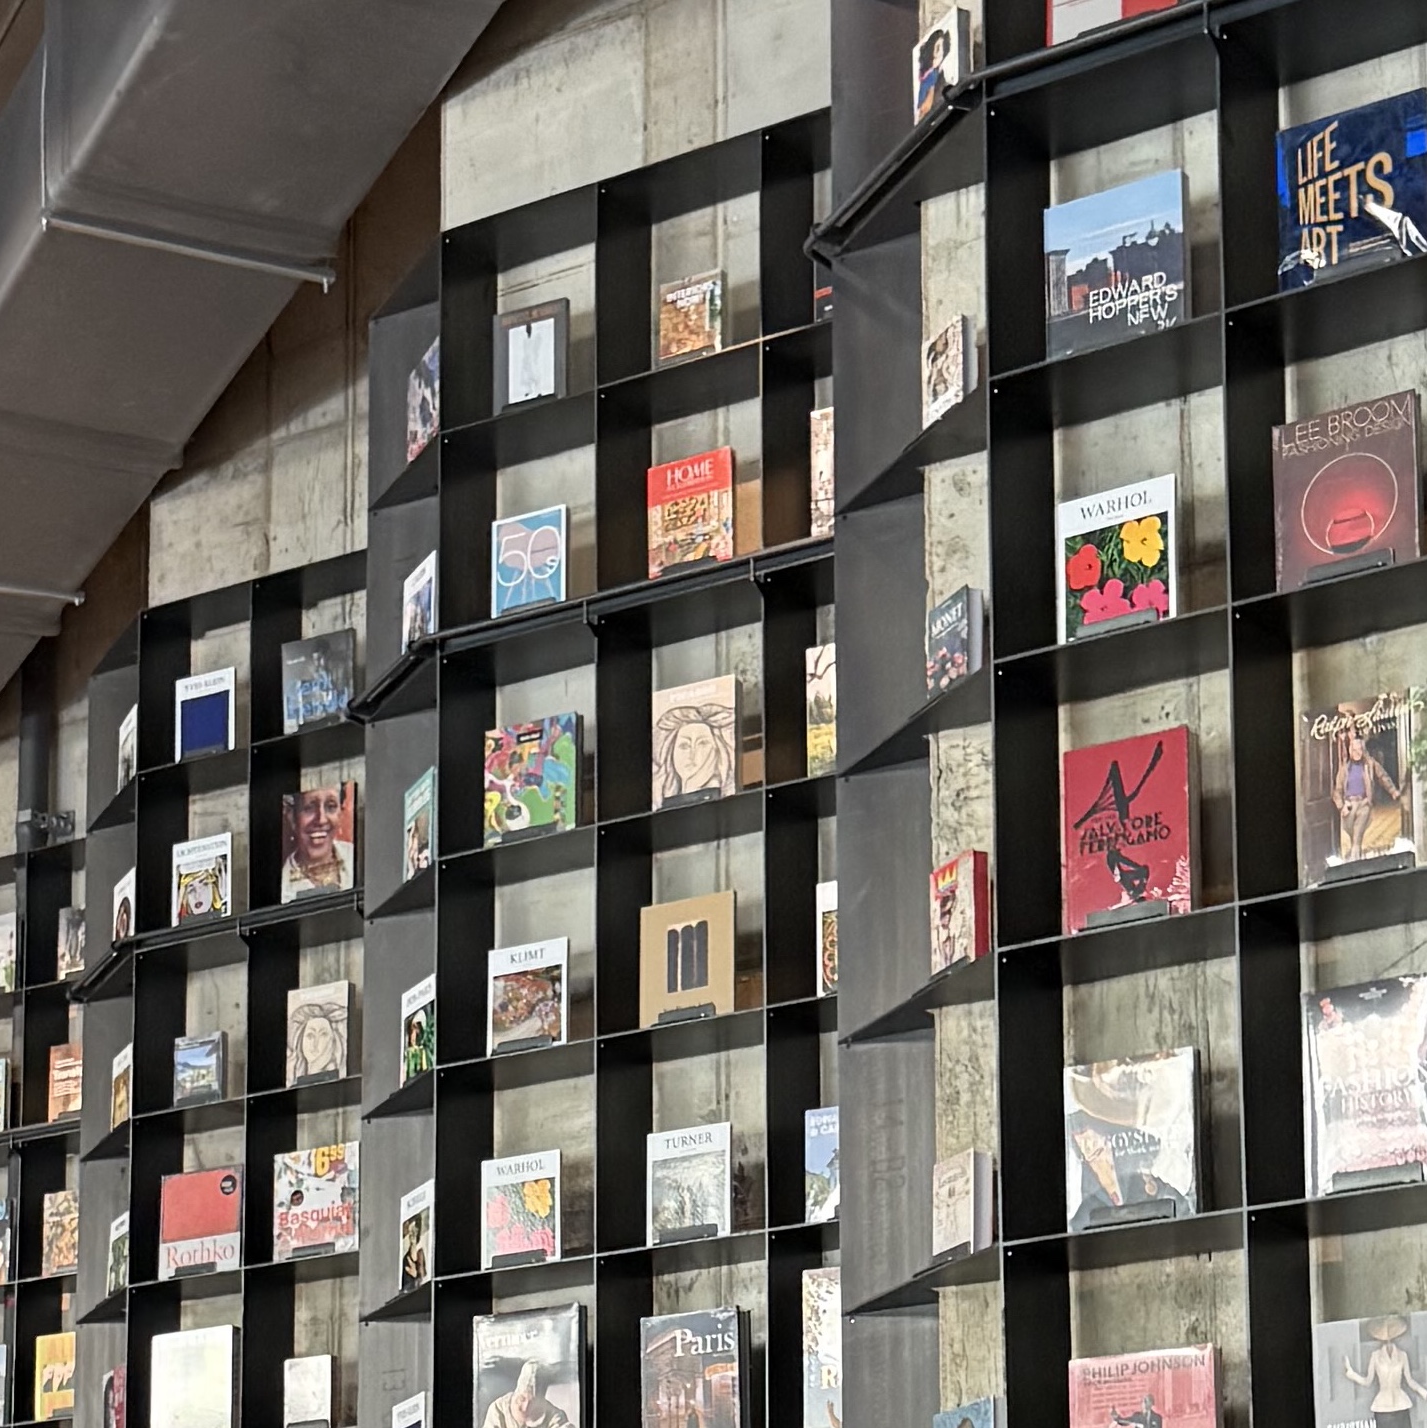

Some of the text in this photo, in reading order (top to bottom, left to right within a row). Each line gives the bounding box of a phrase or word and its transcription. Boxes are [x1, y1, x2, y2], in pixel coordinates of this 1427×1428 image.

[1296, 120, 1339, 185] LIFE
[1298, 152, 1394, 226] MEETS
[1298, 224, 1345, 269] ART
[1089, 272, 1166, 307] EDWARD
[1089, 284, 1178, 324] HOPPER'S
[1282, 392, 1412, 448] LEE BROOM
[1080, 490, 1152, 521] WARHOL
[497, 525, 560, 587] 50s
[510, 948, 545, 964] KLIMT
[665, 1132, 713, 1149] TURNER
[496, 1159, 545, 1175] WARHOL
[167, 1239, 235, 1269] Rothko
[673, 1323, 735, 1357] Paris
[1082, 1354, 1205, 1379] PHILIP JOHNSON
